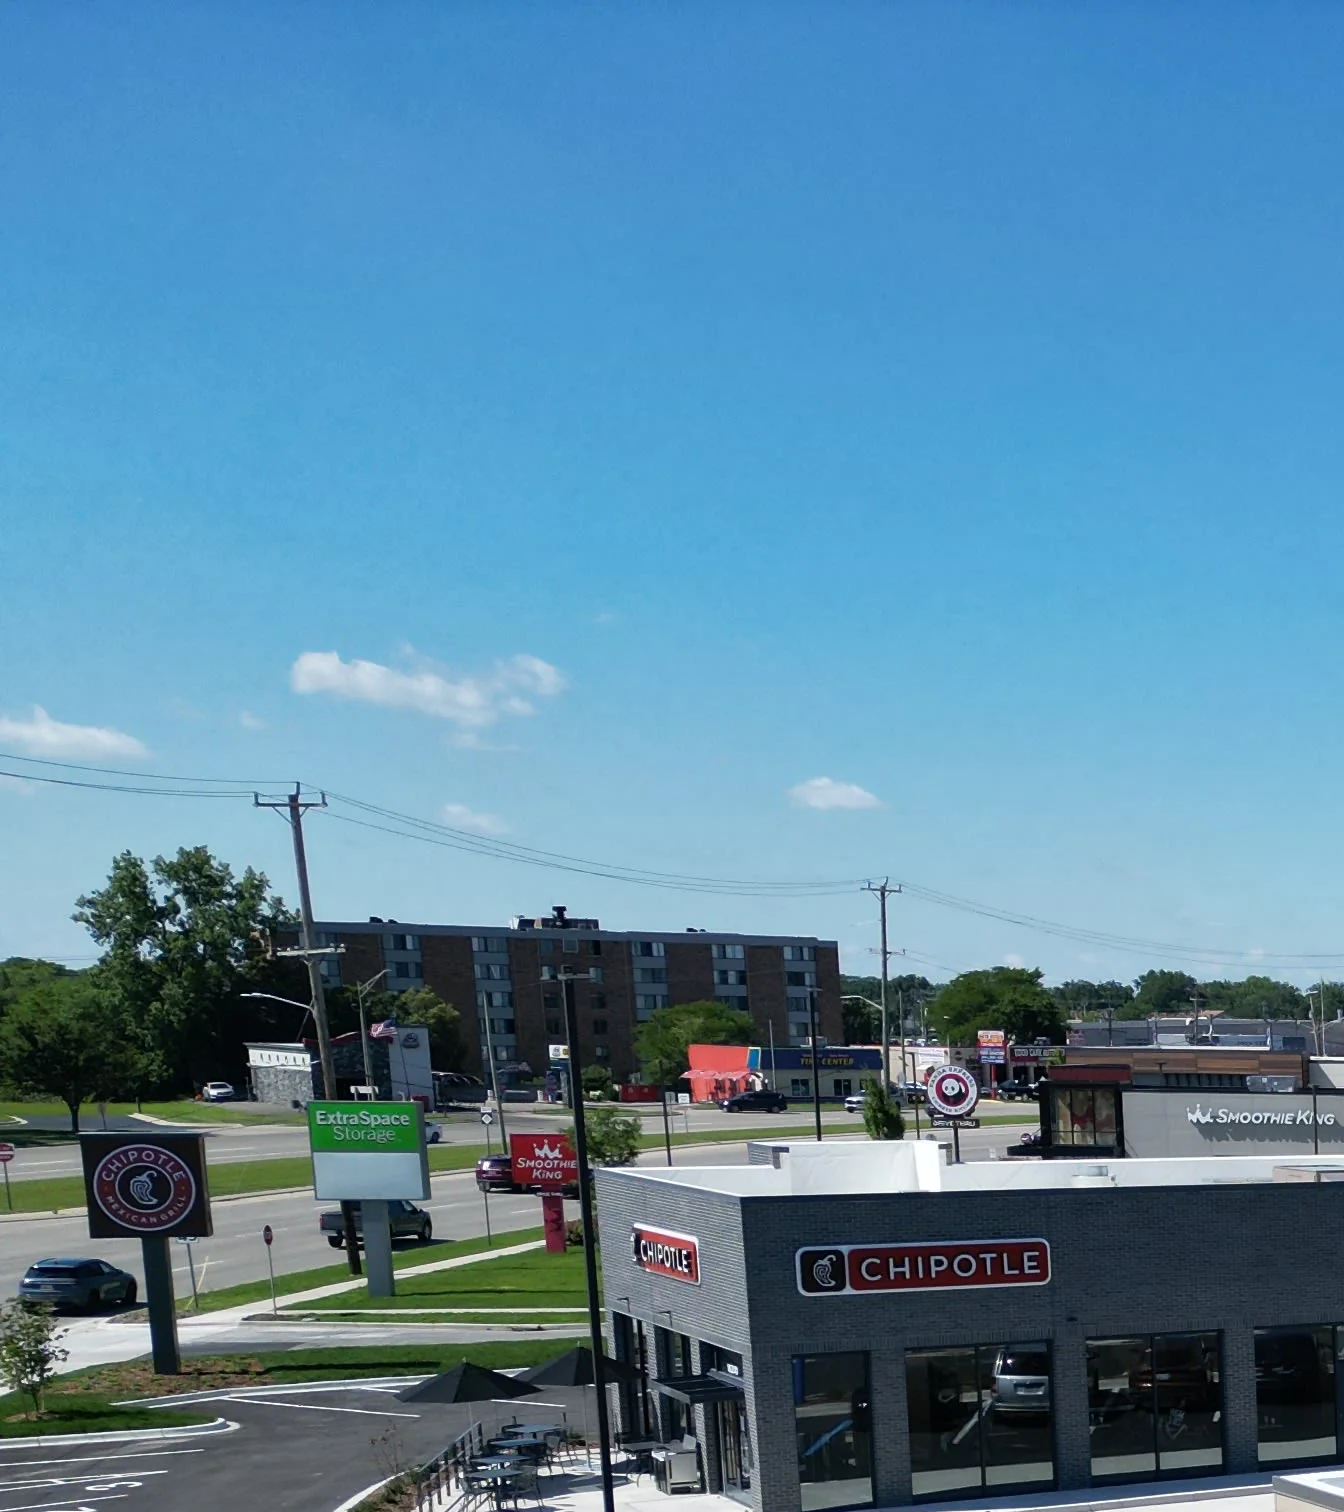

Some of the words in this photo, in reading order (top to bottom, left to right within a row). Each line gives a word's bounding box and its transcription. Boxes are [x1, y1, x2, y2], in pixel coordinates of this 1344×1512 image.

[1216, 1108, 1294, 1124] SMOOTHIE
[333, 1126, 396, 1144] Storage
[102, 1150, 186, 1181] CHIPOTLE
[517, 1157, 577, 1168] SMOOTHIE
[106, 1195, 157, 1224] MEXICAN
[160, 1196, 187, 1221] GRILL
[641, 1240, 688, 1272] CHIPOTLE
[861, 1252, 1041, 1281] CHIPOTLE
